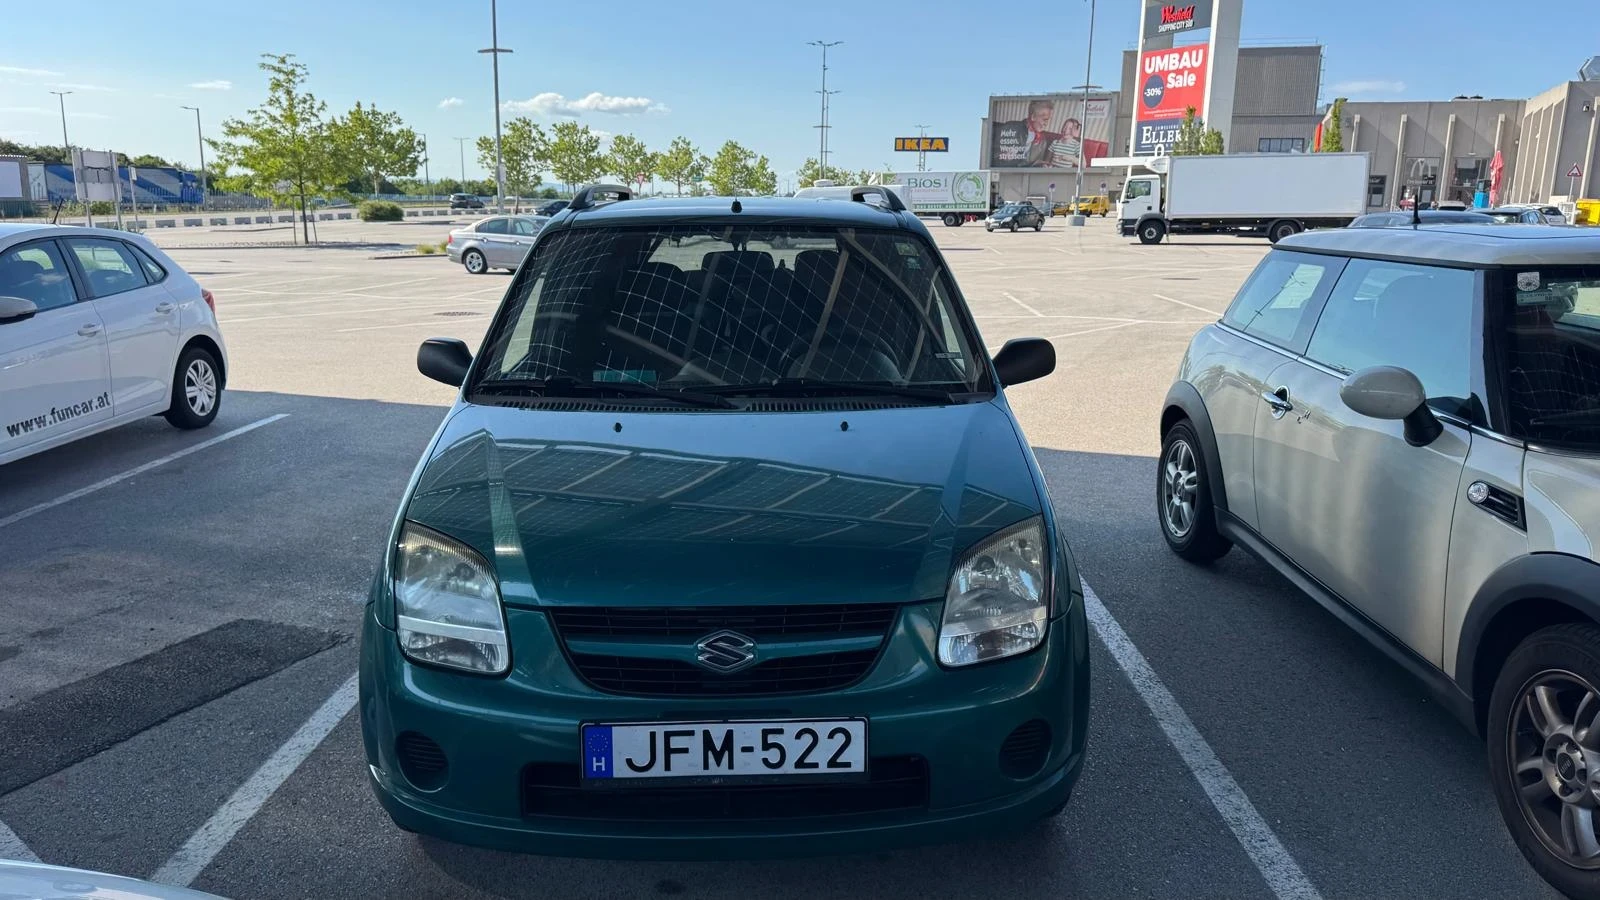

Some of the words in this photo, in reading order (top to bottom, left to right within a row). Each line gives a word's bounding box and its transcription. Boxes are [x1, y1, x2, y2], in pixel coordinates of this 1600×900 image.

[1161, 5, 1195, 24] Westfield
[1144, 49, 1204, 74] UMBAU
[1166, 70, 1197, 89] Sale
[1000, 128, 1017, 137] Mehr
[895, 138, 946, 150] IKEA
[6, 391, 111, 438] www.funcar.at
[592, 756, 606, 773] H
[625, 727, 852, 773] JFM-522
